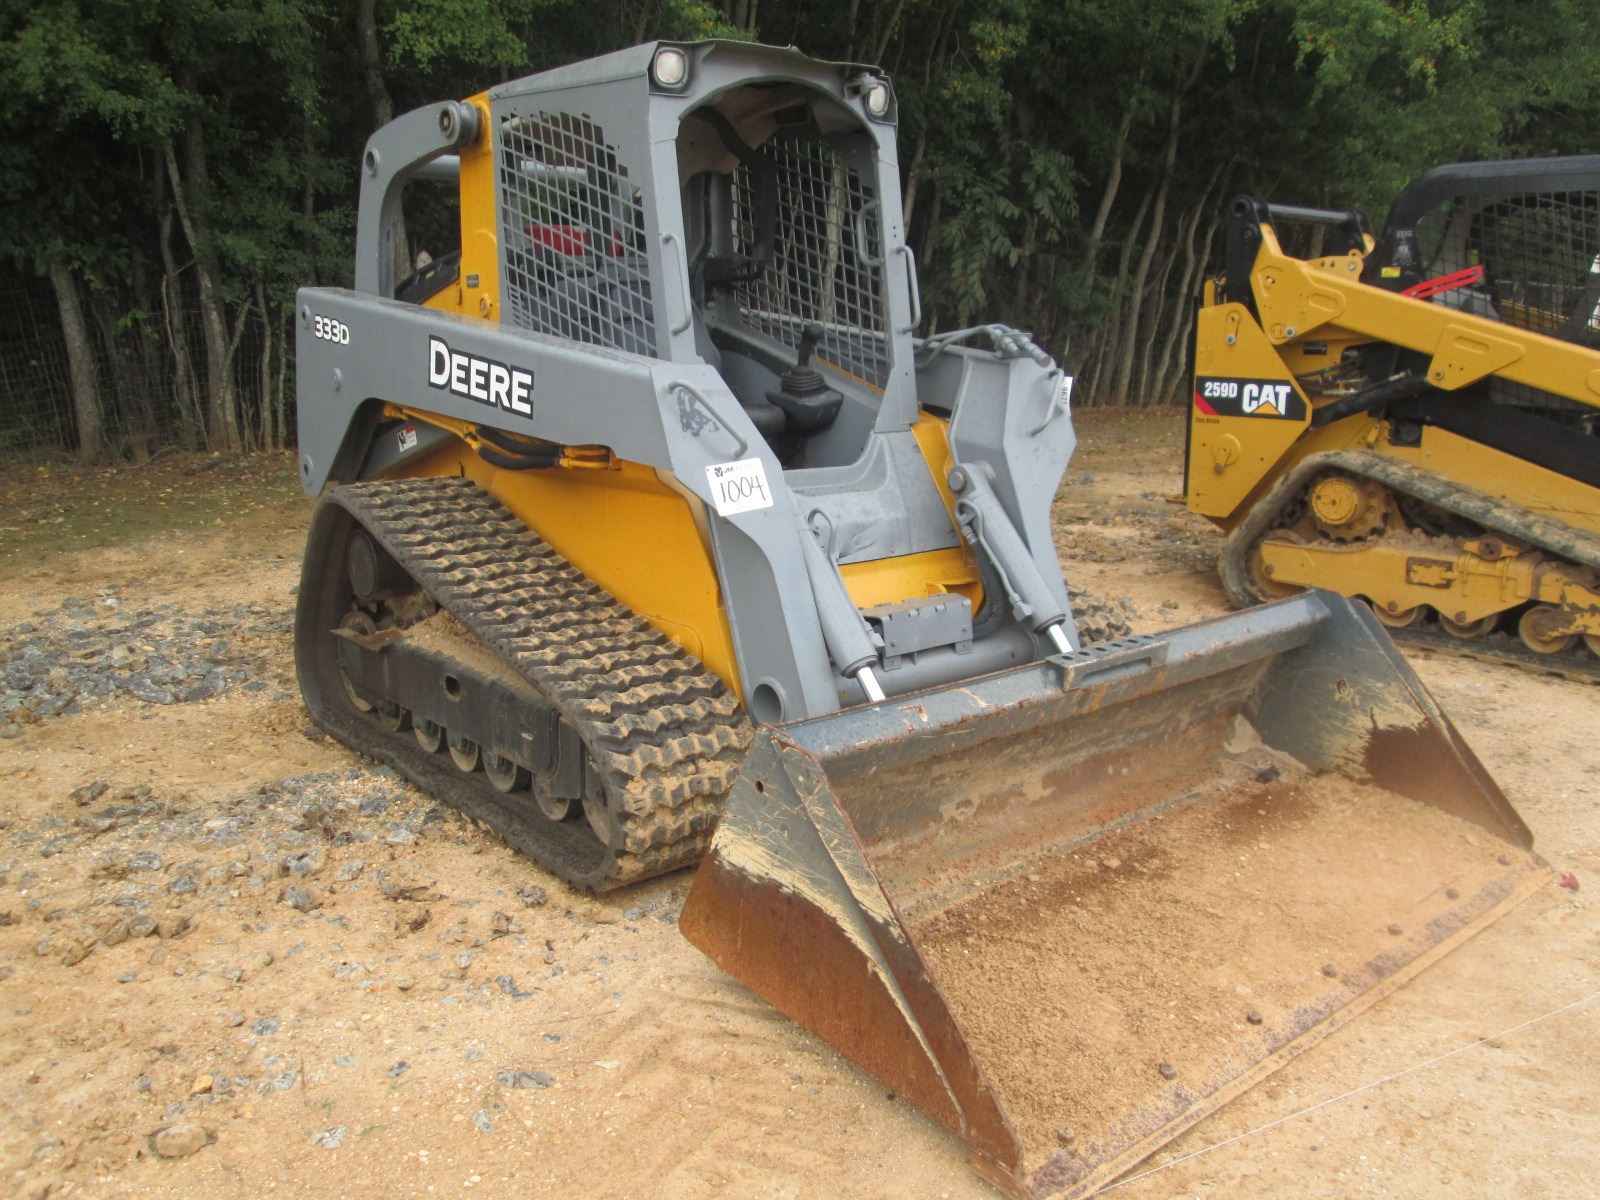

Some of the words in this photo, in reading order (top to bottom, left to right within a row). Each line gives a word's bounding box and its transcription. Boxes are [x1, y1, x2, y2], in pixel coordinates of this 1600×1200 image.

[314, 314, 350, 345] 333D
[429, 335, 534, 418] DEERE
[1204, 381, 1238, 398] 259D
[1242, 383, 1291, 415] CAT
[720, 474, 766, 503] 1004
